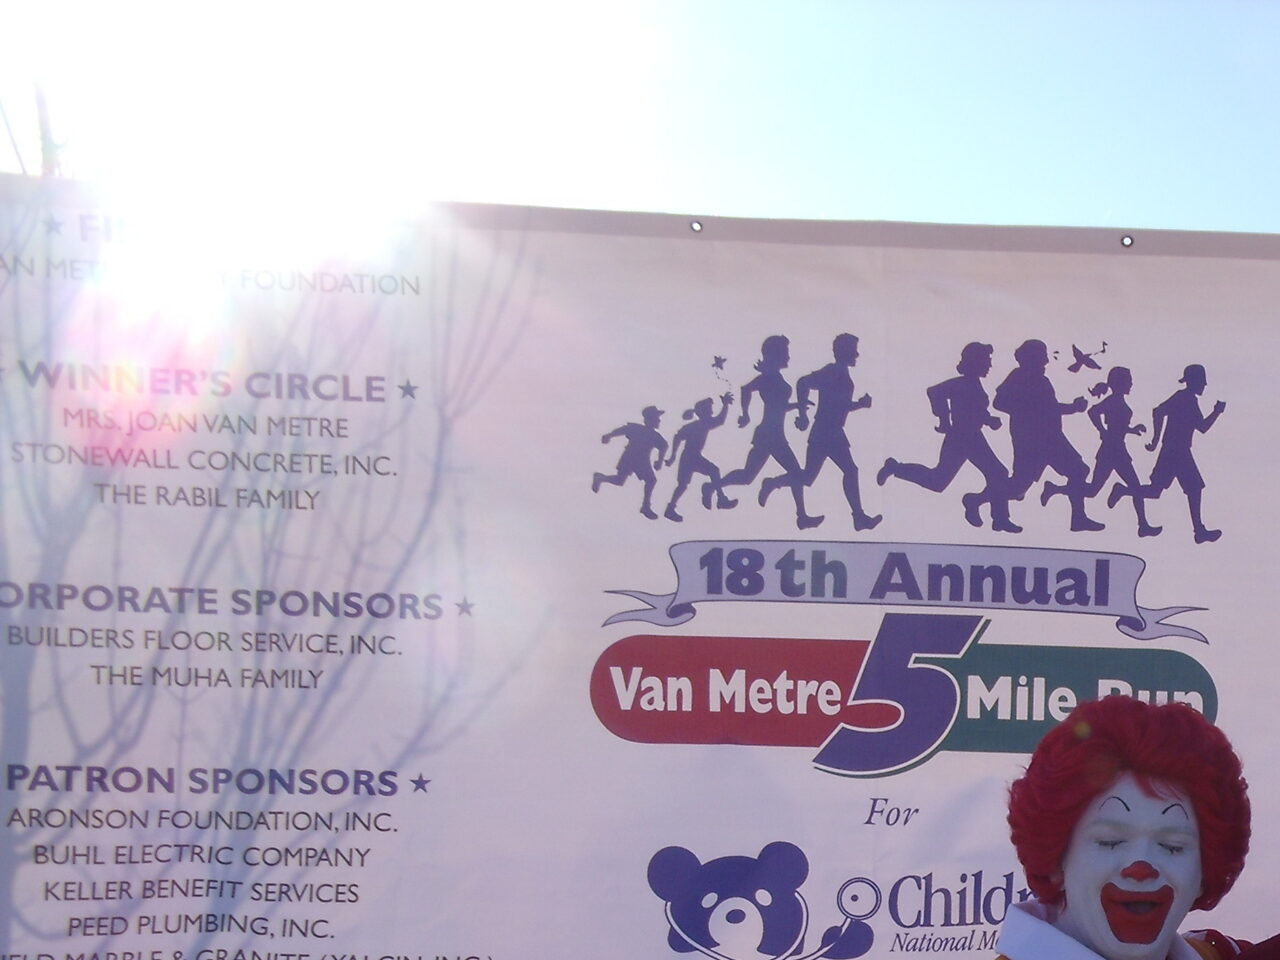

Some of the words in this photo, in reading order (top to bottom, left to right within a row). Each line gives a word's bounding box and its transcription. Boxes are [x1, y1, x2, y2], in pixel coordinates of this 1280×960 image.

[242, 270, 420, 296] FOUNDATION
[18, 360, 232, 398] WINNER'S
[245, 371, 386, 403] CIRCLE
[63, 407, 121, 432] MRS.
[127, 410, 198, 437] JOAN
[203, 413, 257, 436] VAN
[266, 416, 349, 438] METRE
[11, 441, 180, 470] STONEWALL
[187, 449, 338, 476] CONCRETE,
[344, 455, 397, 477] INC.
[93, 482, 146, 505] THE
[156, 485, 227, 508] RABIL
[236, 488, 321, 511] FAMILY
[699, 547, 849, 599] 18th
[869, 551, 1111, 607] Annual
[231, 589, 444, 620] SPONSORS
[8, 625, 134, 650] BUILDERS
[143, 629, 232, 652] FLOOR
[241, 632, 344, 655] SERVICE,
[350, 634, 402, 656] INC.
[90, 664, 143, 686] THE
[151, 666, 231, 688] MUHA
[241, 668, 324, 690] FAMILY
[609, 666, 694, 712] Van
[708, 669, 842, 716] Metre
[812, 612, 990, 779] 5
[967, 675, 1077, 721] Mile
[6, 763, 175, 794] PATRON
[189, 767, 398, 797] SPONSORS
[6, 808, 148, 829] ARONSON
[157, 809, 339, 835] FOUNDATION,
[344, 812, 398, 833] INC.
[864, 798, 919, 828] For
[34, 845, 106, 865] BUHL
[114, 844, 233, 866] ELECTRIC
[242, 846, 371, 869] COMPANY
[44, 880, 133, 901] KELLER
[142, 880, 243, 900] BENEFIT
[250, 882, 359, 903] SERVICES
[68, 916, 128, 937] PEED
[137, 915, 275, 940] PLUMBING,
[282, 919, 335, 939] INC.
[890, 929, 975, 952] National
